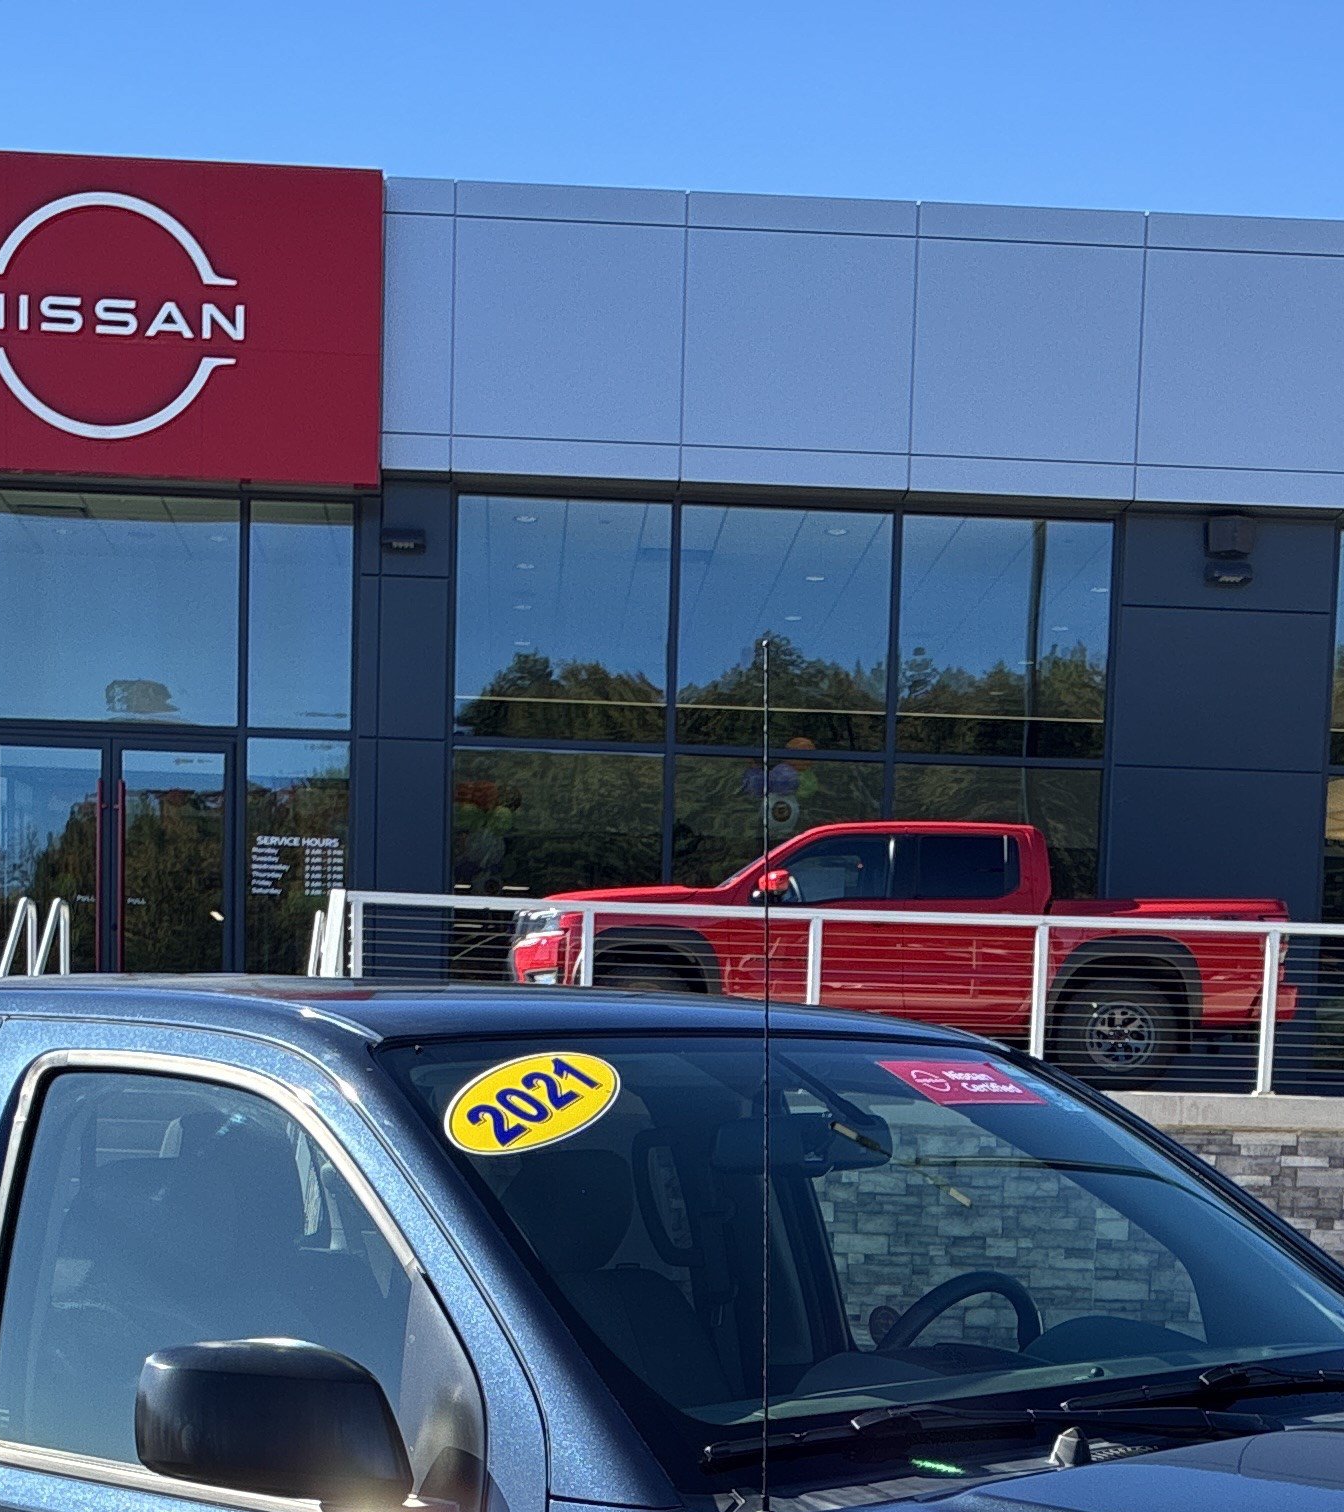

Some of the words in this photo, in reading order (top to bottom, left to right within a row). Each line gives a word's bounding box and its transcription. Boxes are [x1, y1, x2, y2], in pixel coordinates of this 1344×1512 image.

[256, 835, 301, 847] SERVICE
[302, 837, 340, 848] HOURS
[941, 1070, 995, 1082] Nissan
[960, 1081, 1024, 1095] Certified
[466, 1056, 601, 1148] 2021
